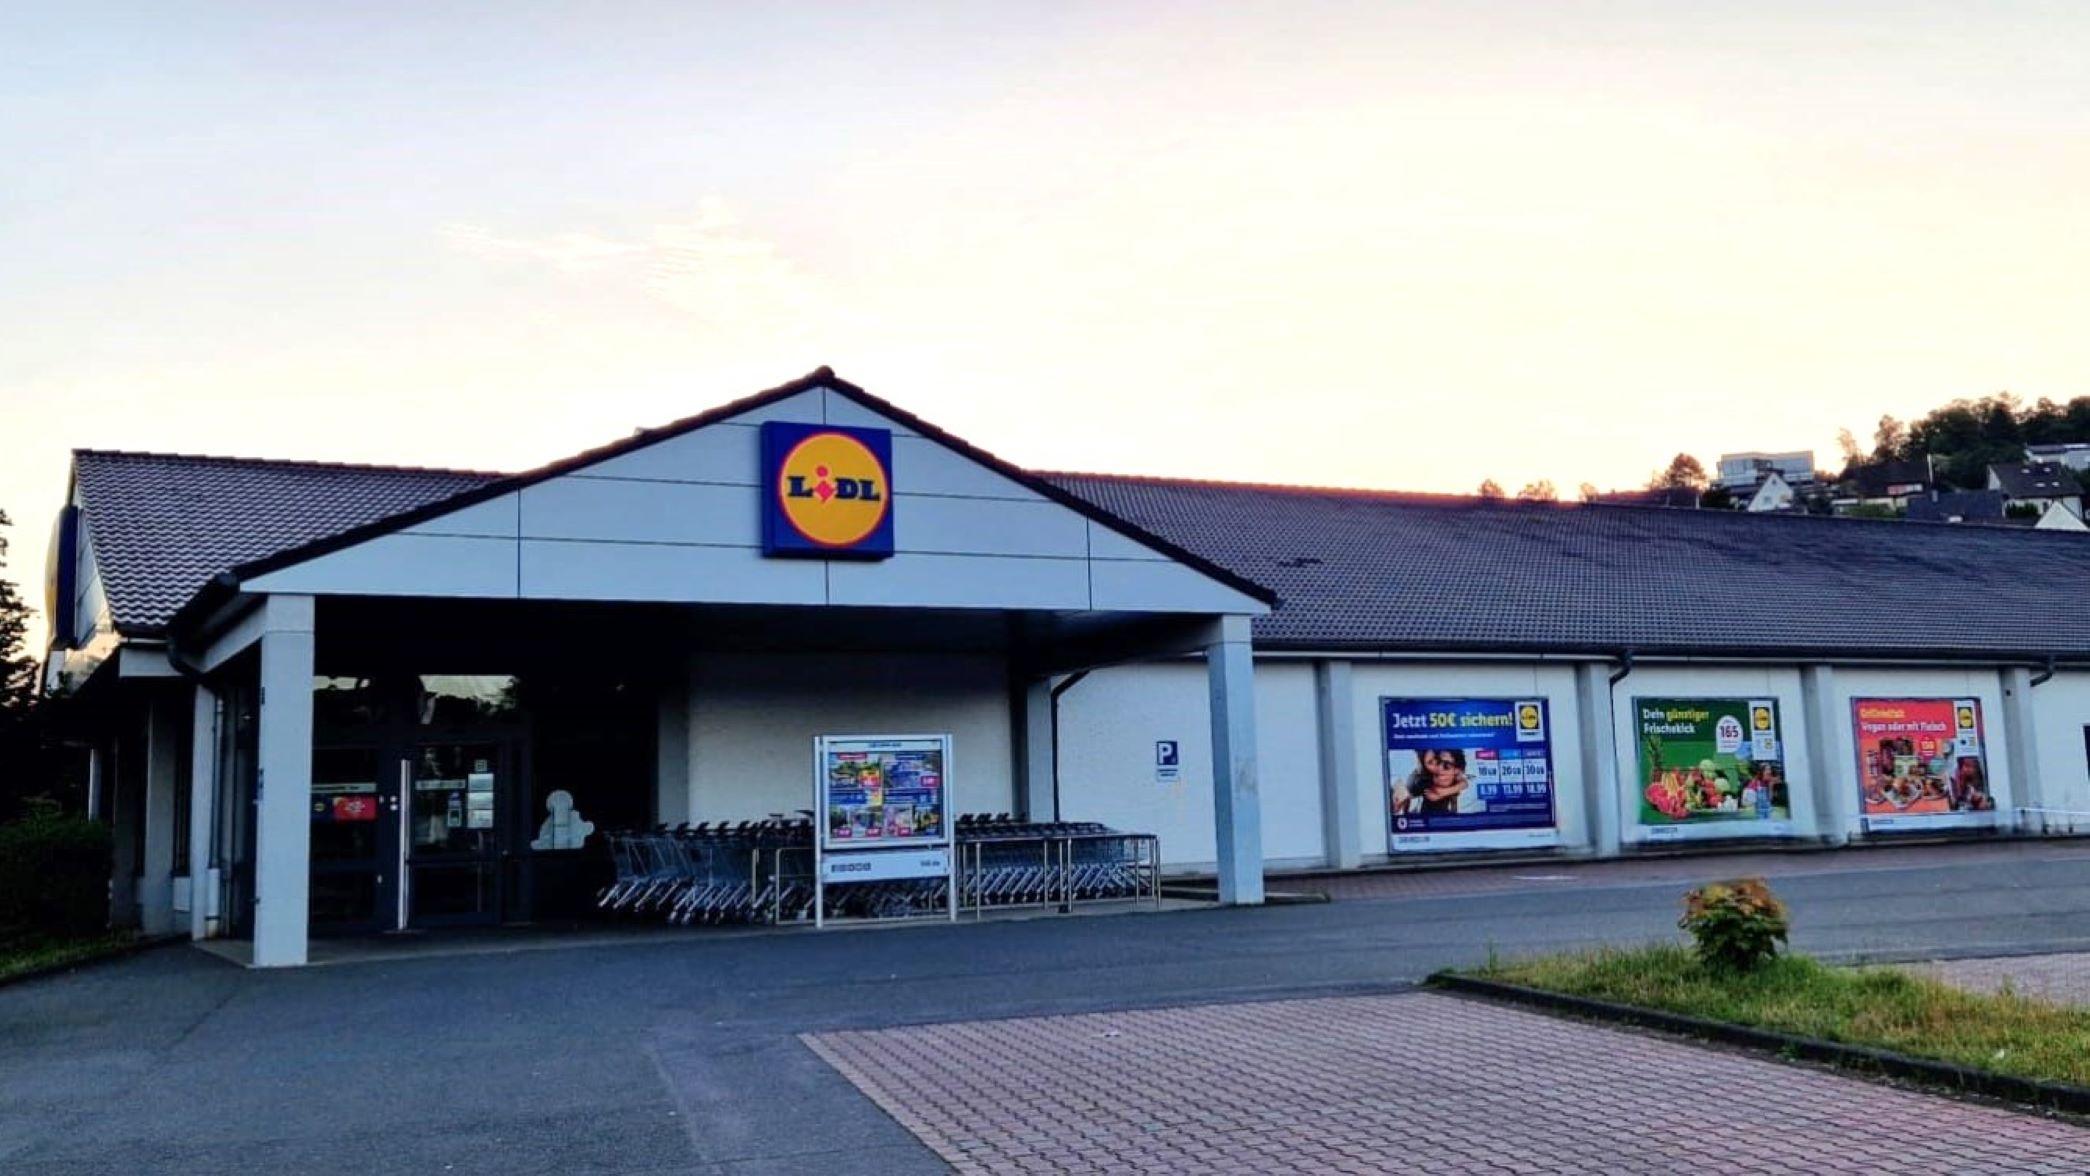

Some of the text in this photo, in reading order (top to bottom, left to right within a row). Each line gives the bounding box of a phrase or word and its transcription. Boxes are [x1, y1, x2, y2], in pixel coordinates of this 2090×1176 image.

[1393, 712, 1427, 728] Jetzt
[1429, 712, 1457, 728] 50€
[1461, 711, 1513, 727] sichern!
[1643, 708, 1709, 722] Dein günstiger
[1644, 722, 1696, 734] Frischekick
[1158, 743, 1172, 764] P
